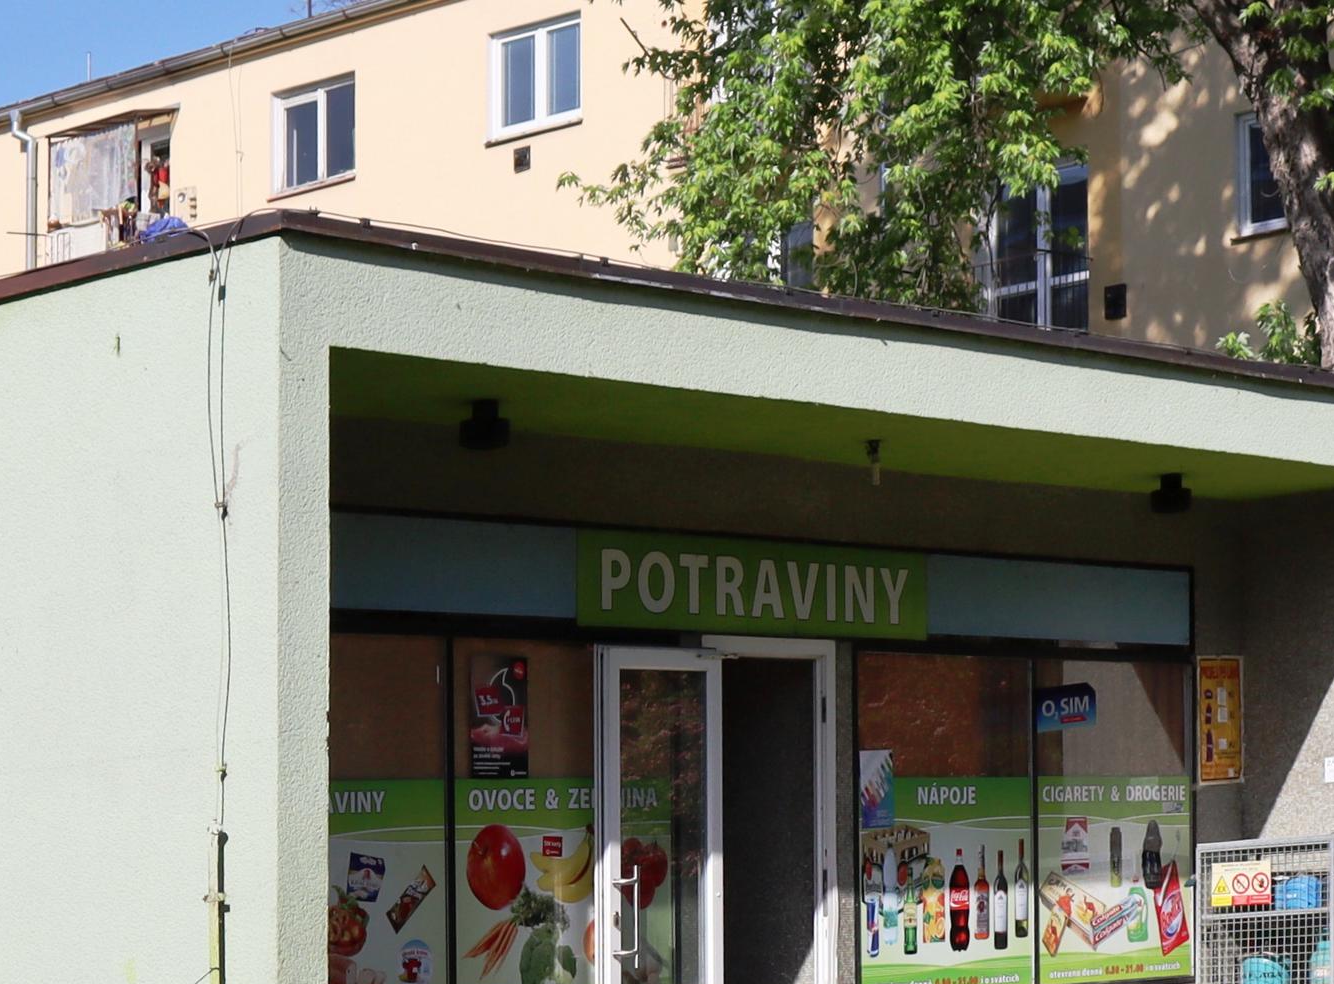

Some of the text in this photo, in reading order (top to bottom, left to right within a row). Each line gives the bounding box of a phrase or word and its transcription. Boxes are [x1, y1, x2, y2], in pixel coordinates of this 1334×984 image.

[600, 548, 909, 625] POTRAVINY
[1060, 695, 1090, 717] SIM
[468, 788, 536, 811] OVOCE
[545, 788, 559, 810] &
[917, 782, 977, 806] NÁPOJE
[1042, 784, 1186, 802] CIGARETY & DROGERIE
